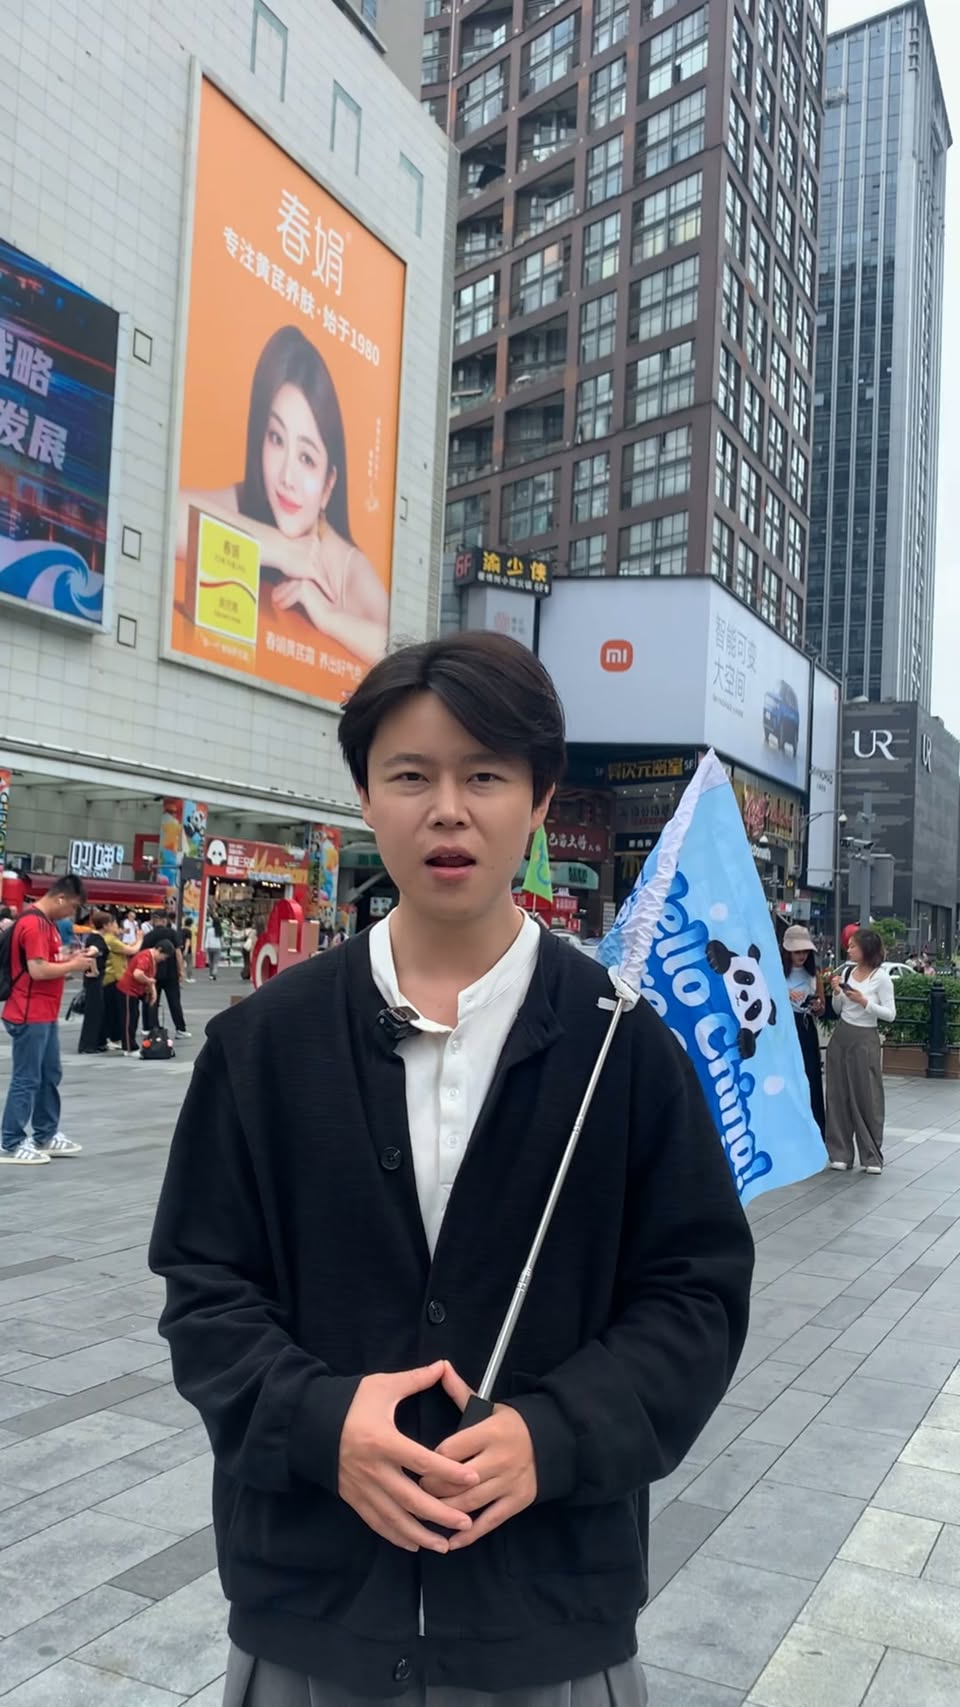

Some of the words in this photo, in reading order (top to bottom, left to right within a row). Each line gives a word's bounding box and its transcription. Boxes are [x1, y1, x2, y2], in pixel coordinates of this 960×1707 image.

[275, 188, 345, 297] 春娟
[0, 398, 68, 473] 发展
[455, 553, 472, 578] 6F
[715, 612, 757, 674] 智能可变
[713, 656, 746, 705] 大空间
[851, 729, 899, 761] UR
[920, 733, 933, 773] UR
[694, 1012, 771, 1192] China!
